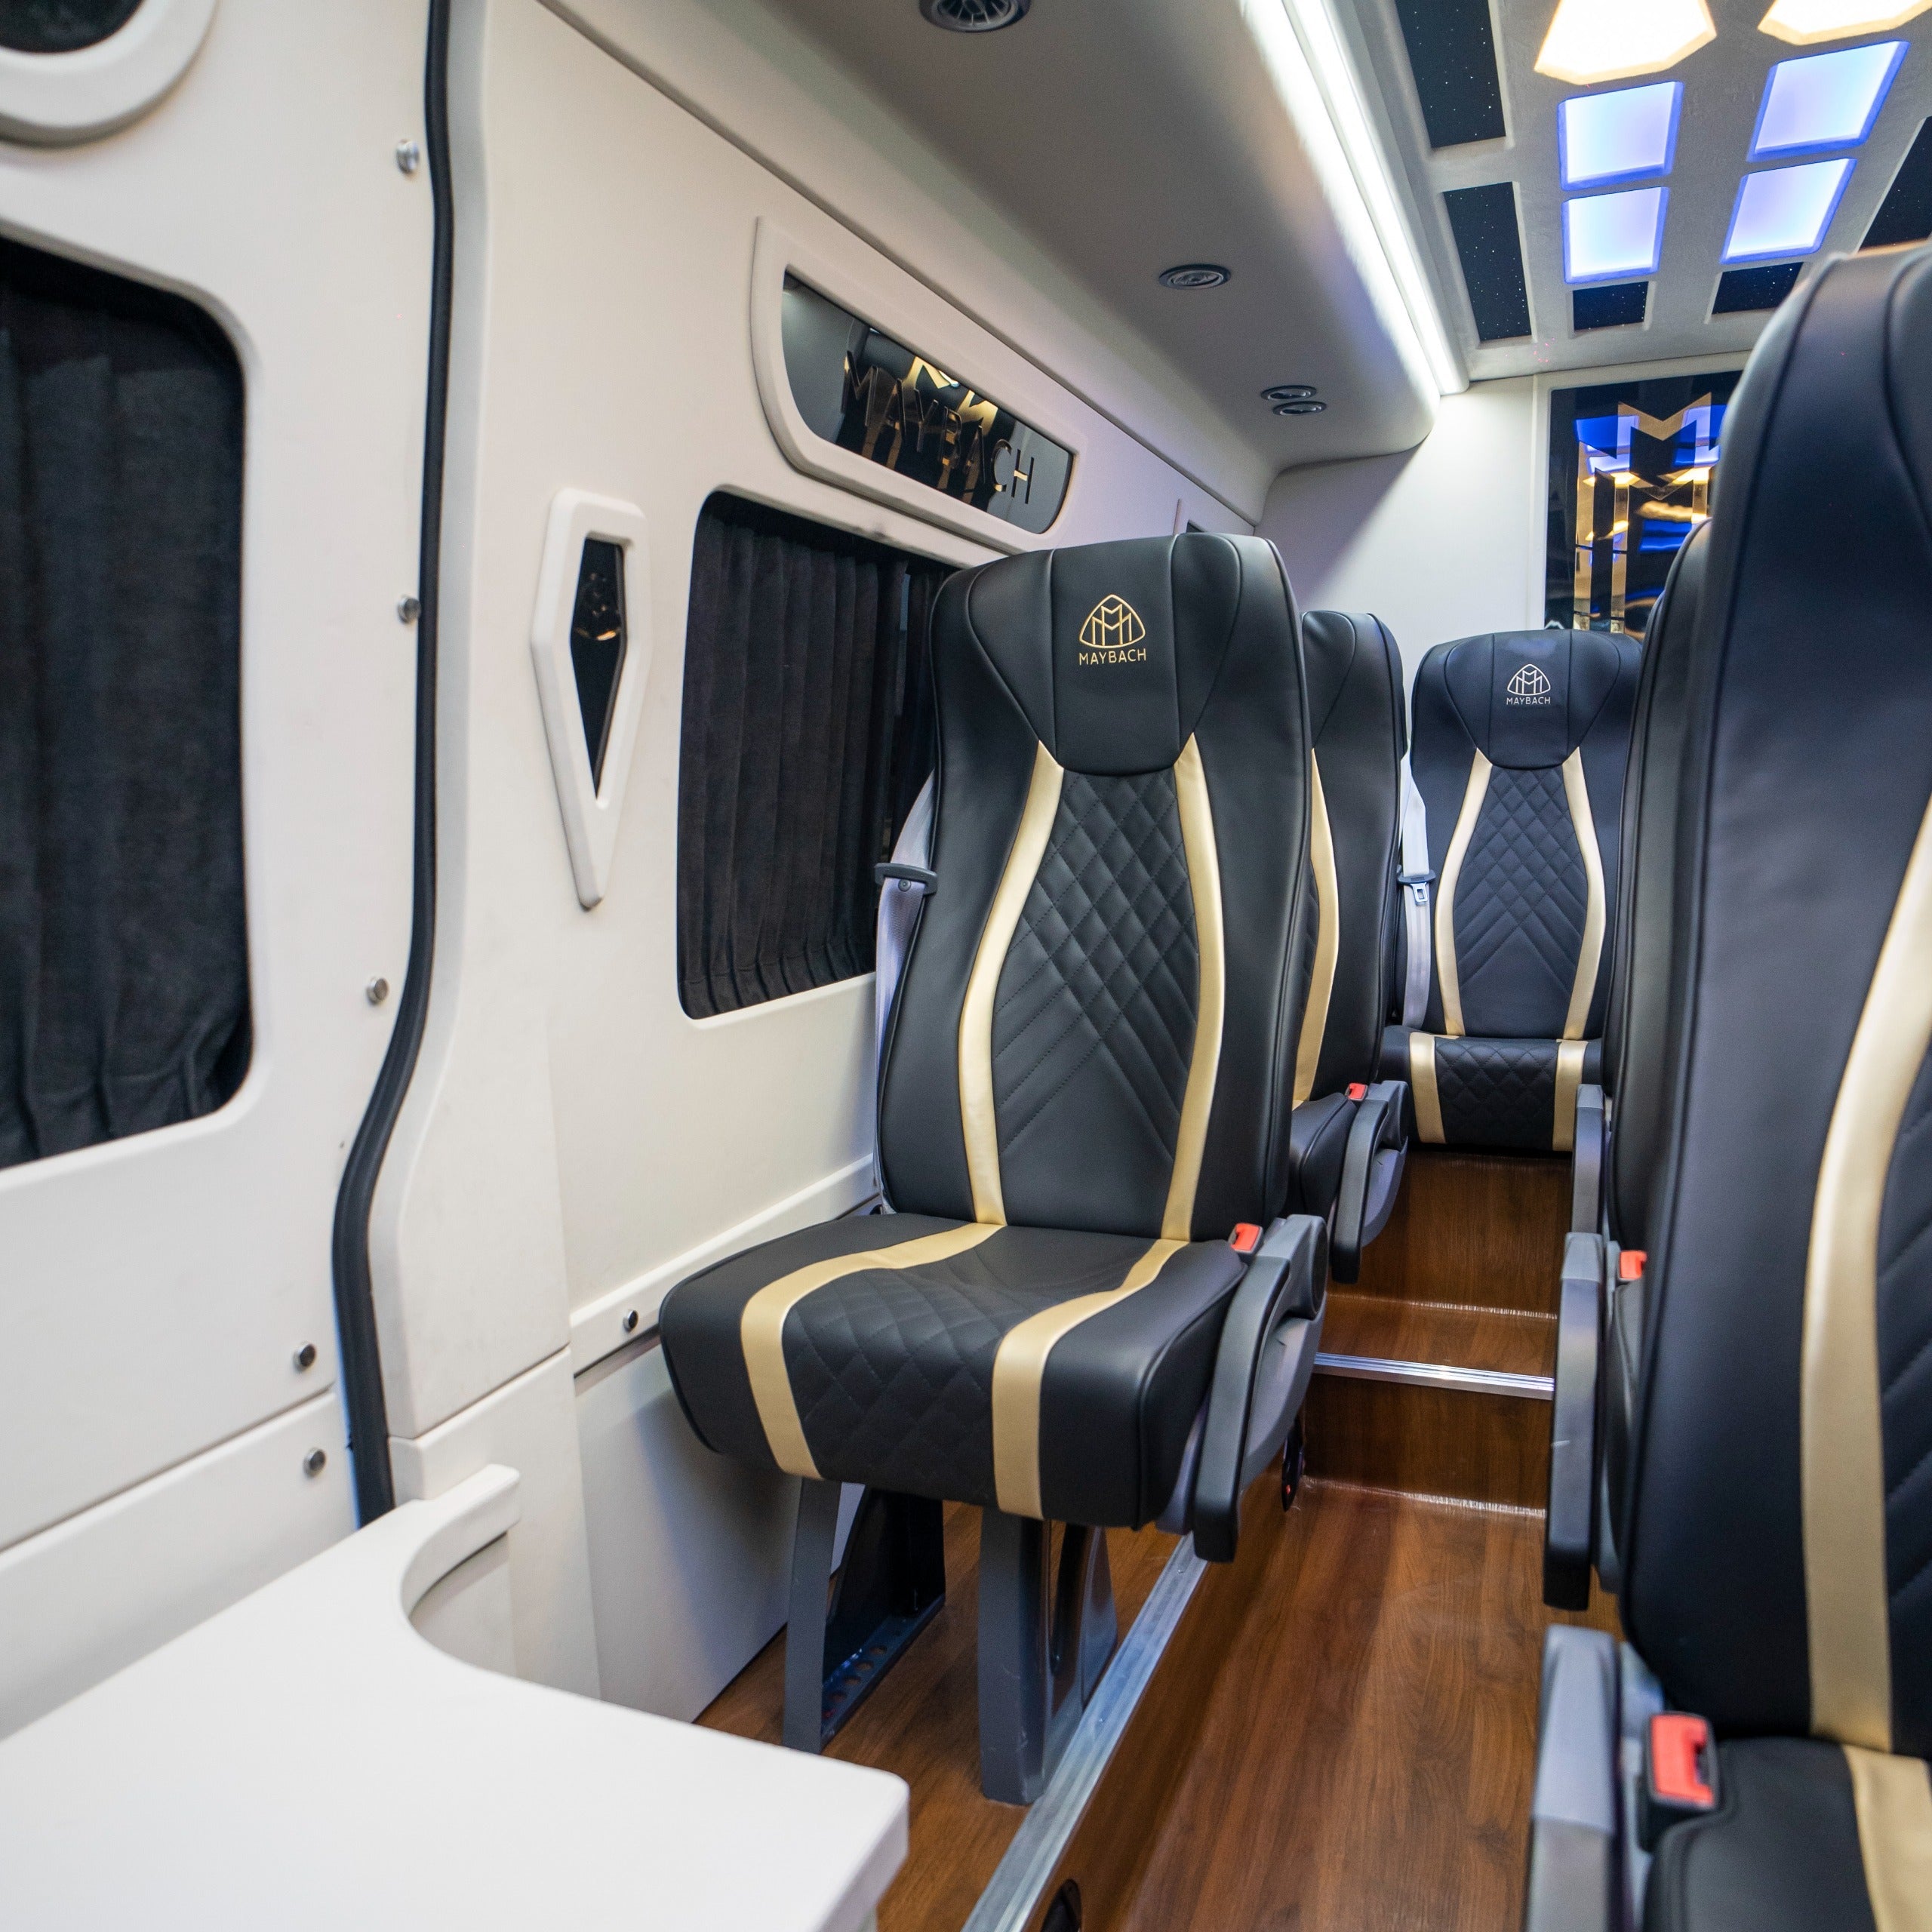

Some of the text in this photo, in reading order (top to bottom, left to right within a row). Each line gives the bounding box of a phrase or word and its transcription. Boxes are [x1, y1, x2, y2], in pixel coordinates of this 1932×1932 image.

[841, 350, 1035, 505] MAYBACH
[1078, 648, 1146, 666] MAYBACH
[1506, 697, 1551, 705] MAYBACH
